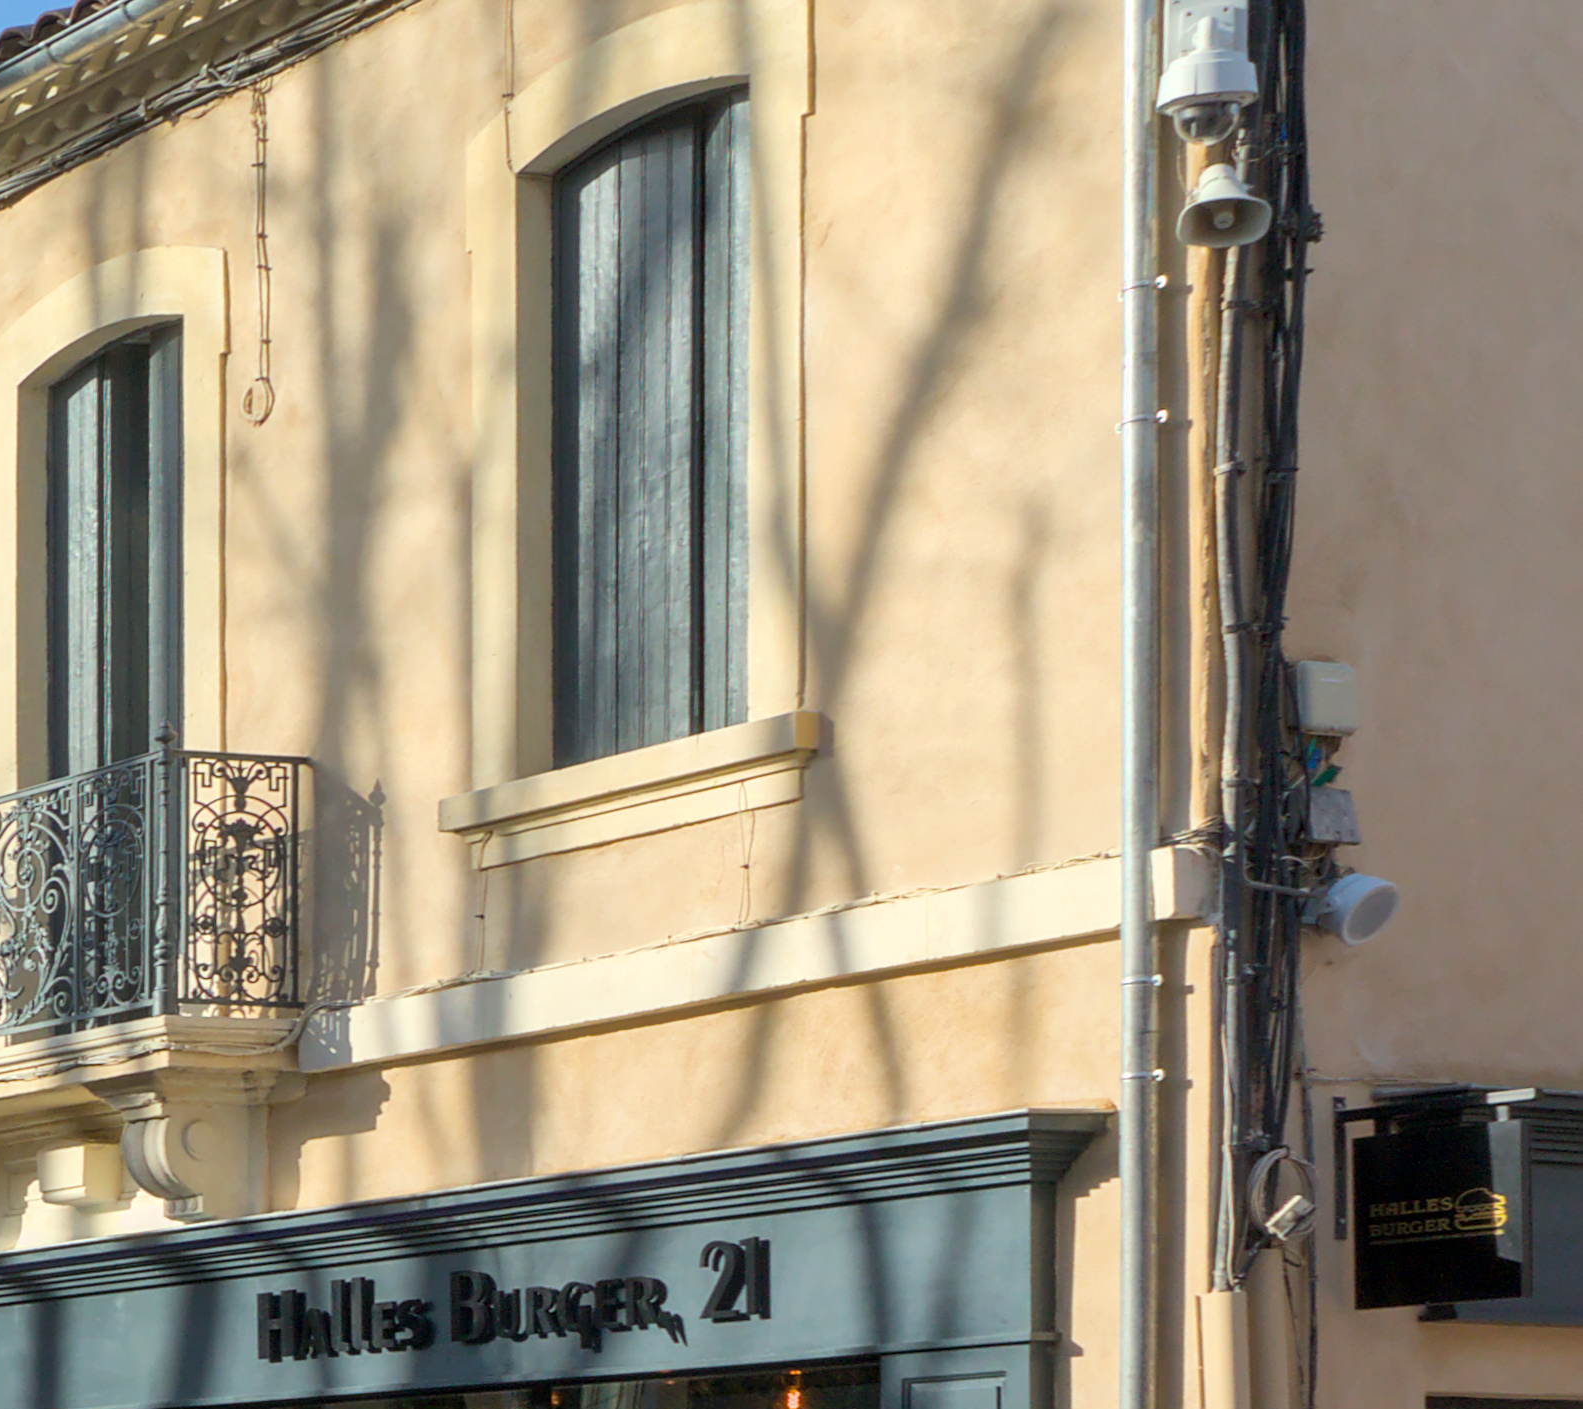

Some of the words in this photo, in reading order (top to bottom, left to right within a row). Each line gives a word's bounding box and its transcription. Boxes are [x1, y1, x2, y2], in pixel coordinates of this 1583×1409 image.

[1370, 1197, 1452, 1217] HALLES
[1370, 1218, 1452, 1237] BURGER
[698, 1236, 771, 1324] 21
